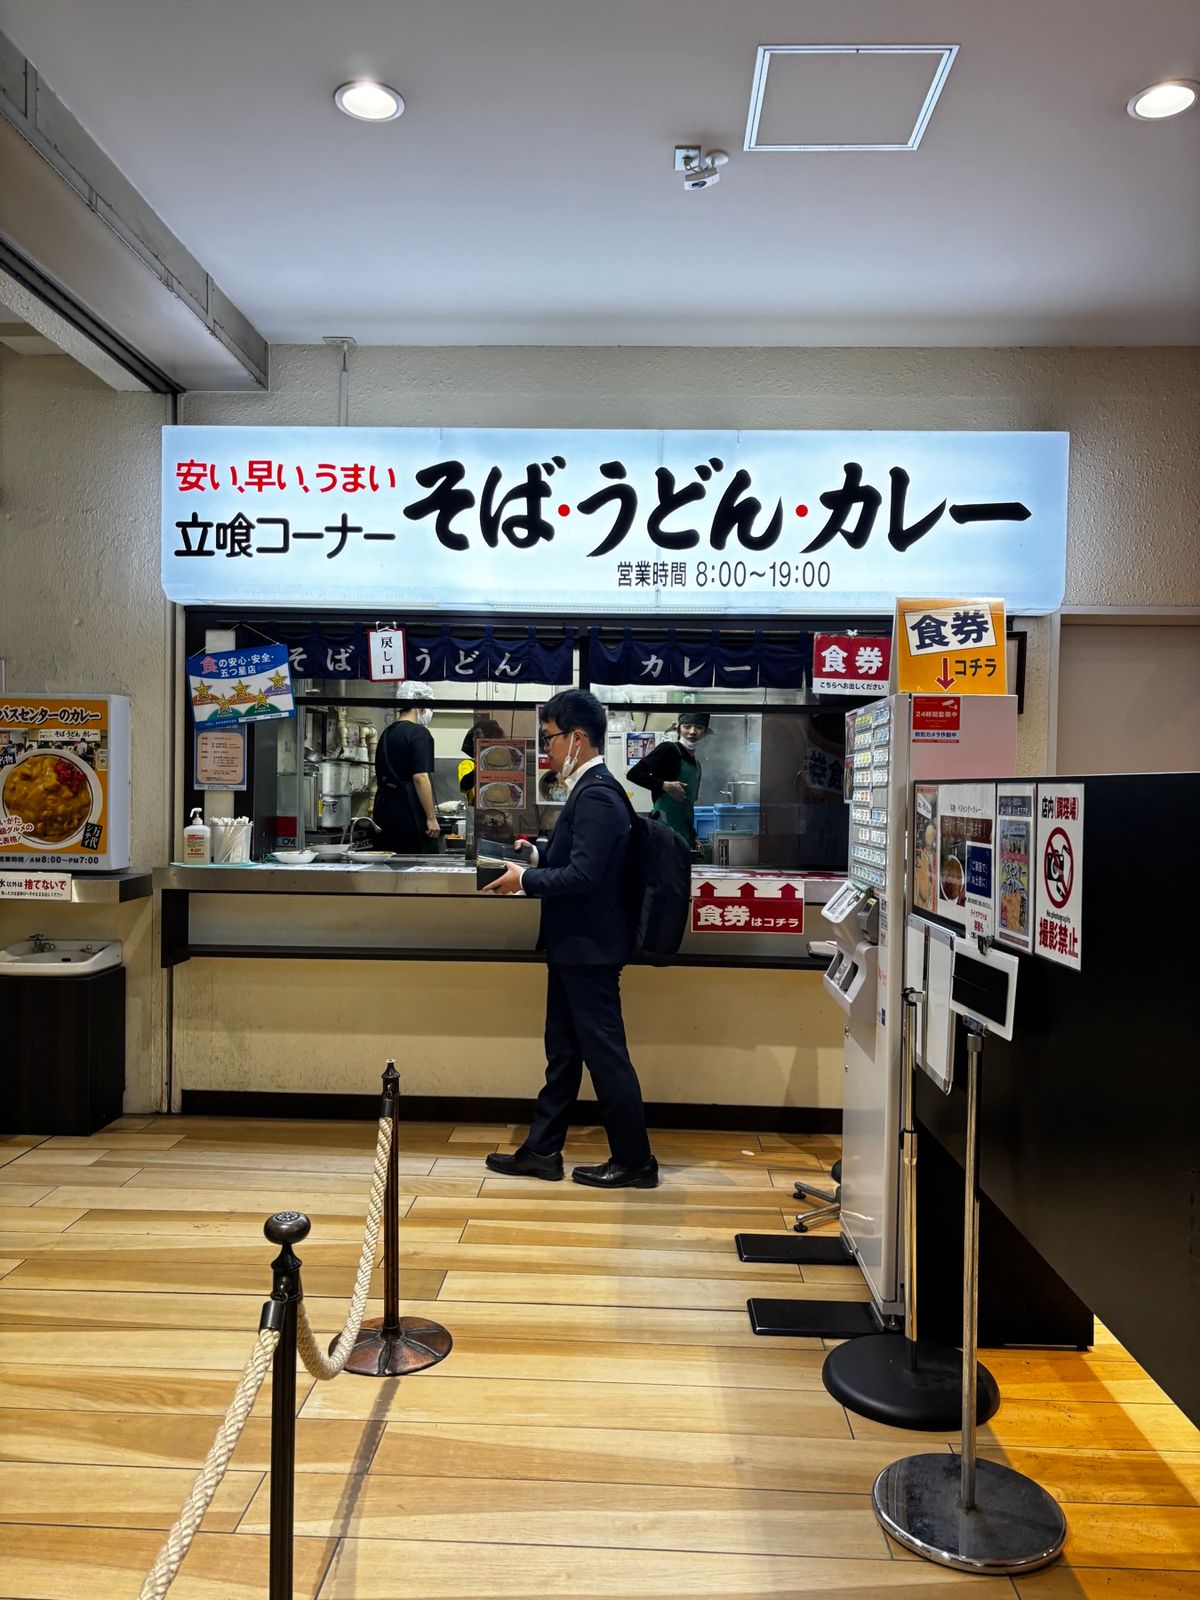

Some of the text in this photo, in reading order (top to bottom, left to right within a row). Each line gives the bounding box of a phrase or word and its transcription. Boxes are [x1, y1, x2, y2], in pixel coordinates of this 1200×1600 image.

[176, 459, 396, 494] 安い、早い、うまい
[174, 511, 396, 559] 立喰コーナー
[616, 560, 688, 588] 営業時間
[909, 609, 990, 651] 食券
[289, 645, 522, 677] そば うどん
[380, 636, 394, 675] 戻し口
[640, 654, 751, 679] カレー
[820, 644, 884, 675] 食券
[954, 658, 997, 677] コチラ
[220, 665, 257, 678] 五つ星店
[819, 681, 885, 691] こちらへお出しください
[24, 878, 67, 891] 捨てないで
[1039, 916, 1078, 958] 撮影禁止
